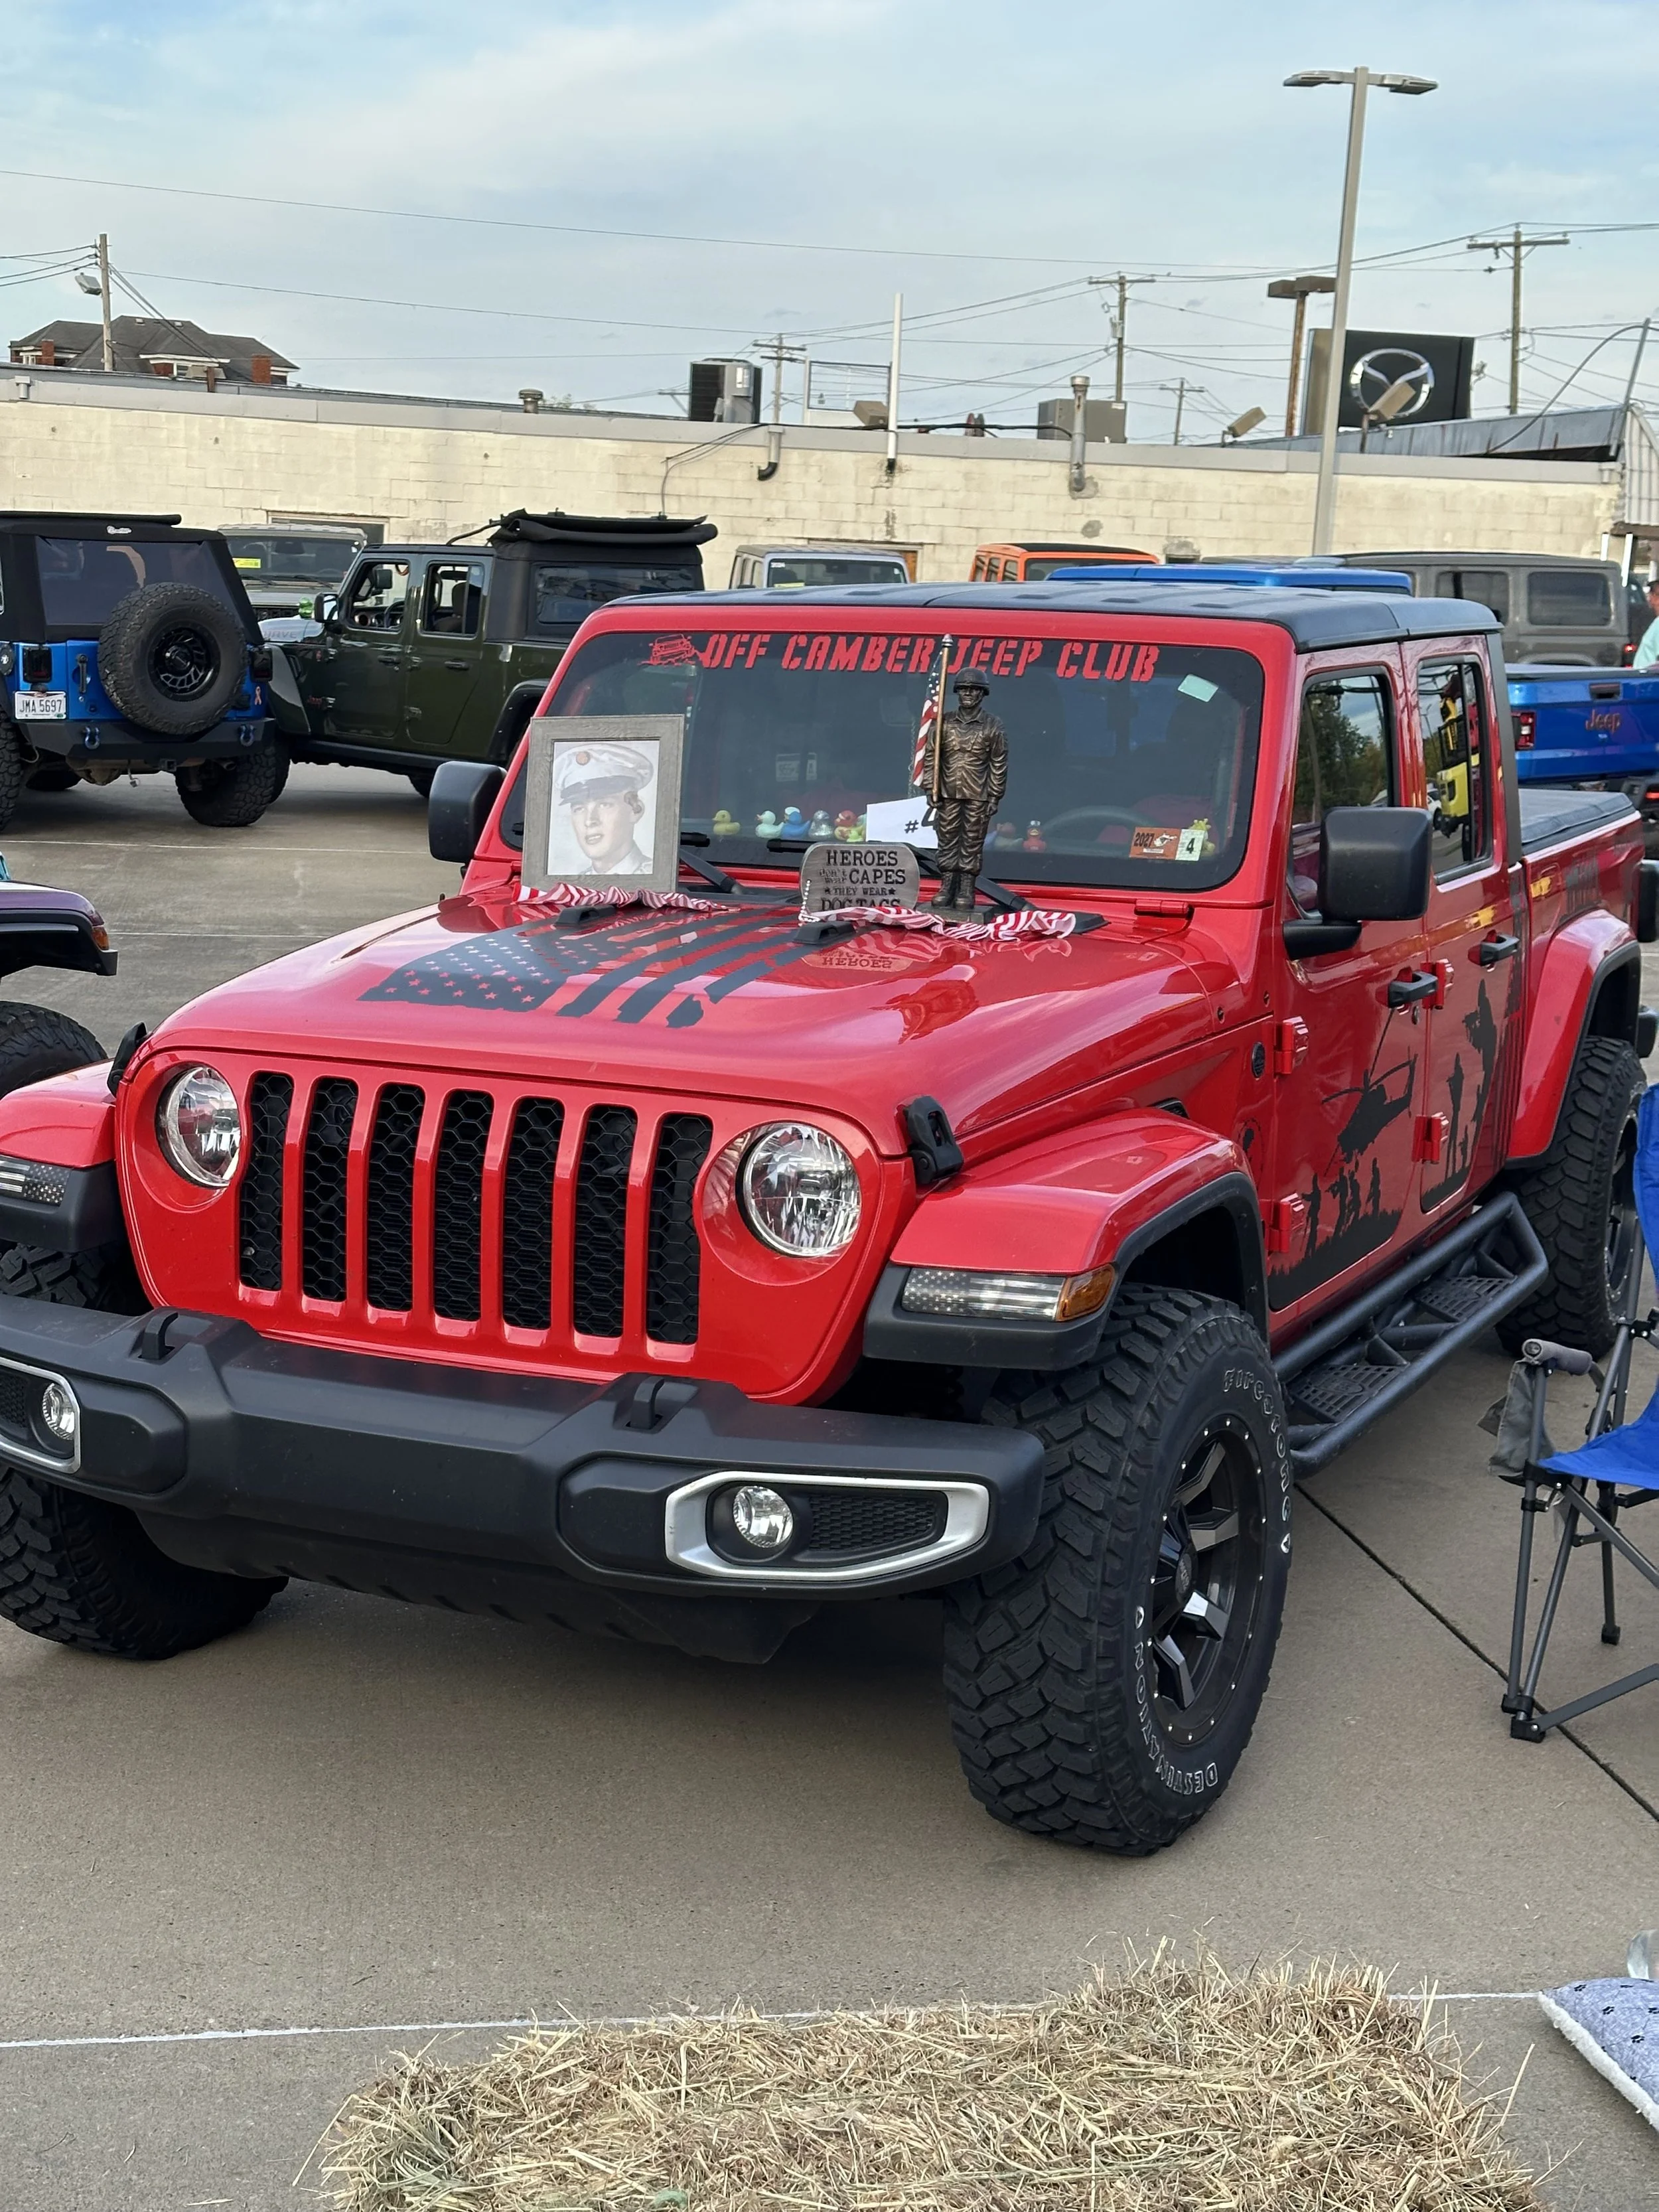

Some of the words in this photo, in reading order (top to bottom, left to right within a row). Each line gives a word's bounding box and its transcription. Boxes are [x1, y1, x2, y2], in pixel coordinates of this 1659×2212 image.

[702, 633, 771, 670] OFF
[781, 634, 936, 674] CAMBER
[947, 638, 1044, 678] JEEP
[1056, 642, 1161, 682] CLUB
[19, 700, 36, 713] JMA
[39, 700, 62, 713] 5697
[1585, 708, 1622, 735] Jeep
[1133, 832, 1155, 848] 2027
[1186, 837, 1196, 854] 4
[827, 849, 899, 867] HEROES
[849, 868, 906, 885] CAPES
[833, 887, 858, 896] THEY
[863, 887, 887, 896] WEAR
[820, 897, 853, 912] DOG
[1134, 1641, 1218, 1795] DESTINATION
